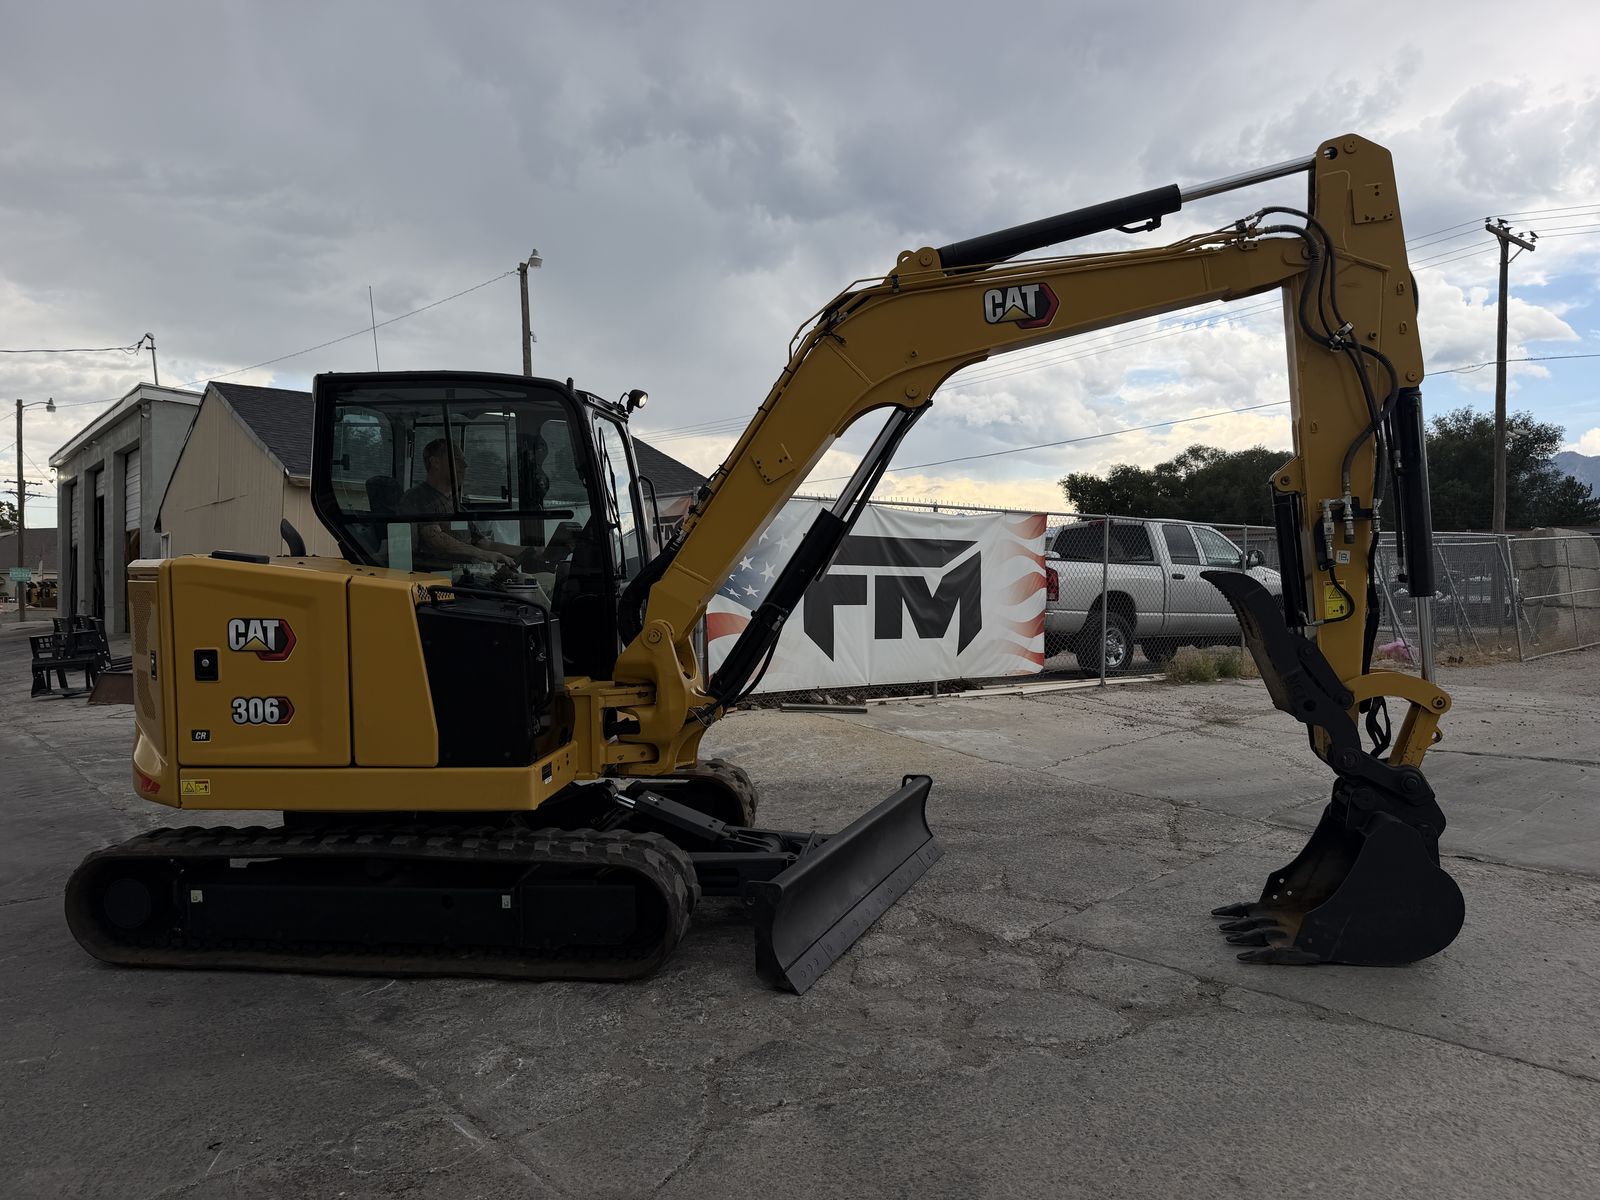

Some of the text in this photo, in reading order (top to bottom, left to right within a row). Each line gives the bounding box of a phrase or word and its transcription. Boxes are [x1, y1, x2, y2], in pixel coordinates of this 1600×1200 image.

[984, 284, 1040, 323] CAT
[228, 619, 280, 651] CAT
[232, 697, 280, 724] 306
[195, 731, 207, 740] CR
